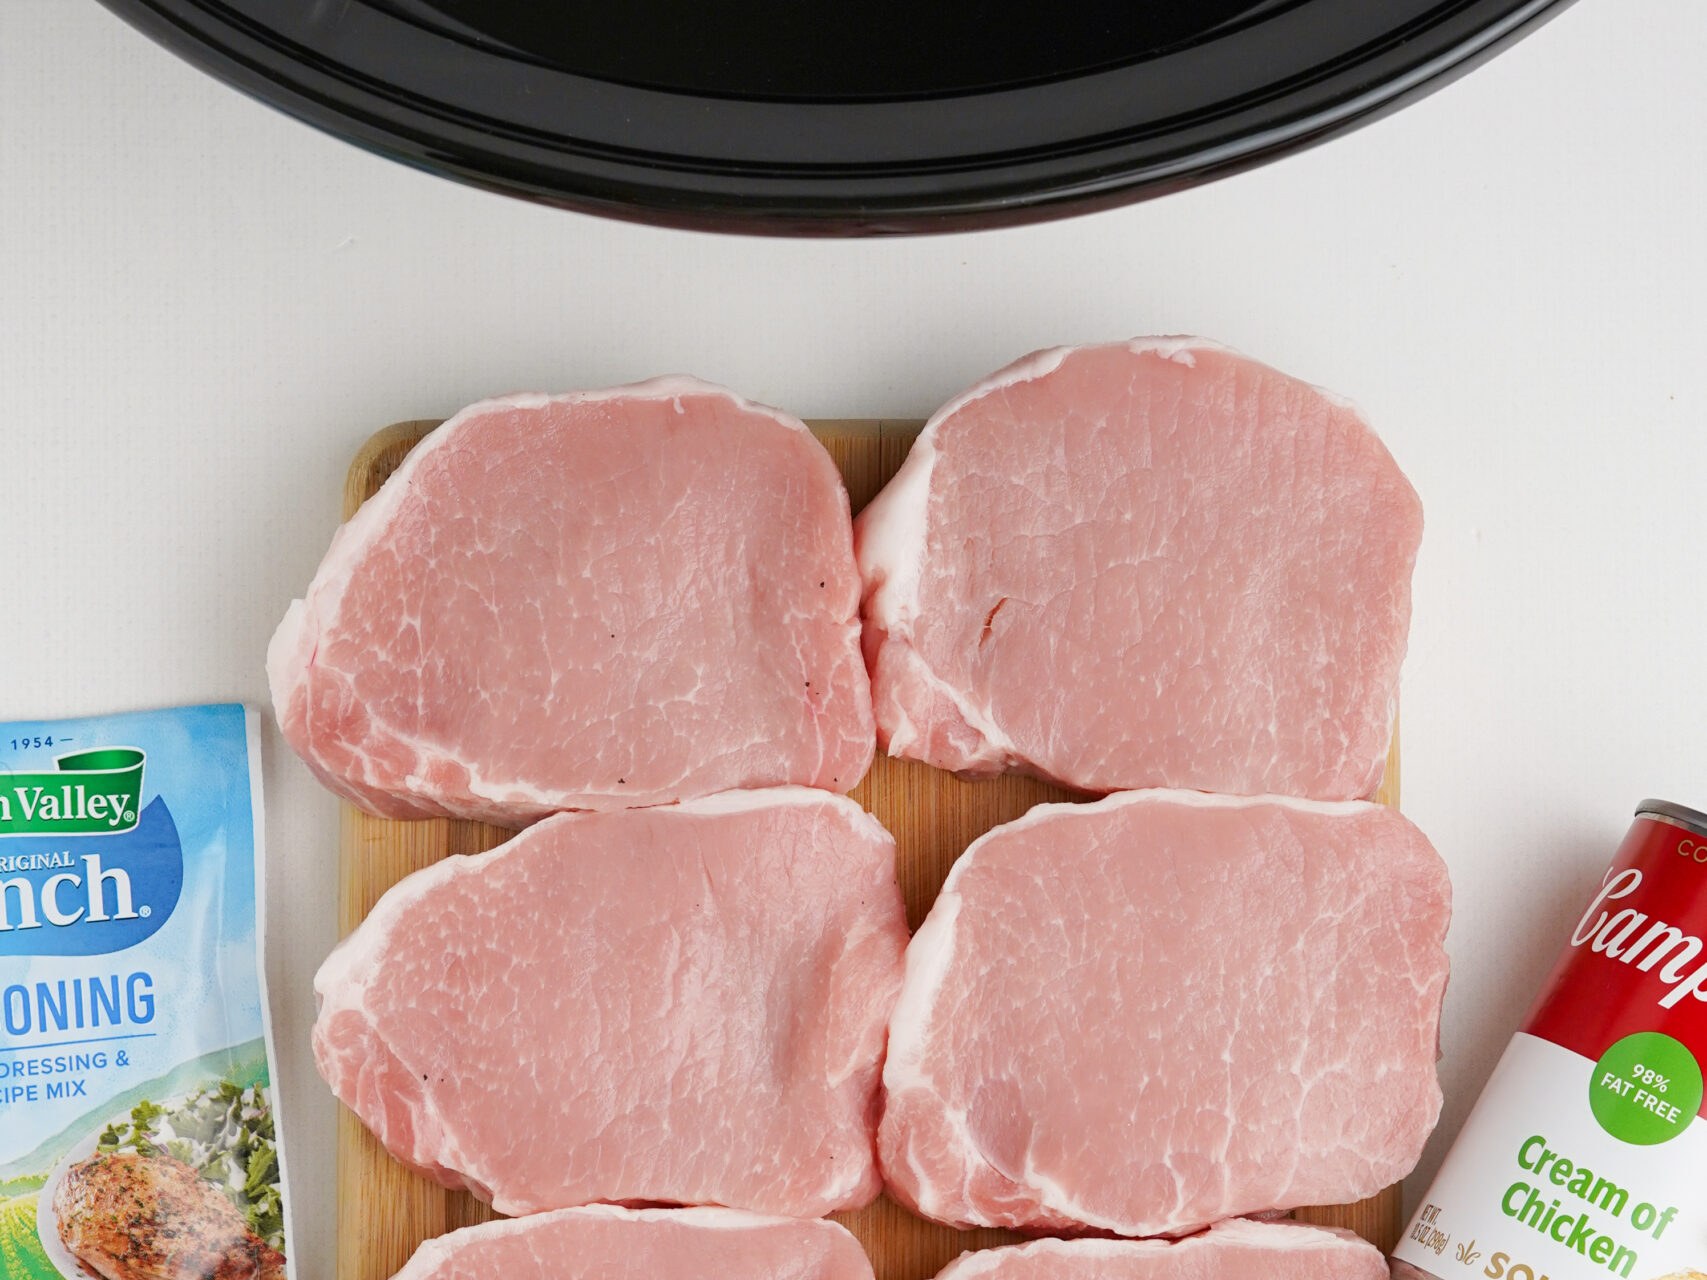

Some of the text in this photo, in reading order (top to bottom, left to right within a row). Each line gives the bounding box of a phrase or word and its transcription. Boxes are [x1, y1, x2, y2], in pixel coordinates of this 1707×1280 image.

[11, 735, 53, 751] 1954
[14, 785, 130, 826] Valley
[1678, 839, 1707, 863] CO
[3, 971, 156, 1036] ONING
[115, 1050, 130, 1067] &
[0, 1079, 88, 1105] IPE MIX
[1632, 1063, 1671, 1093] 98%
[1600, 1072, 1682, 1124] FAT FREE
[1517, 1135, 1679, 1241] Cream of
[1501, 1181, 1639, 1280] Chicken
